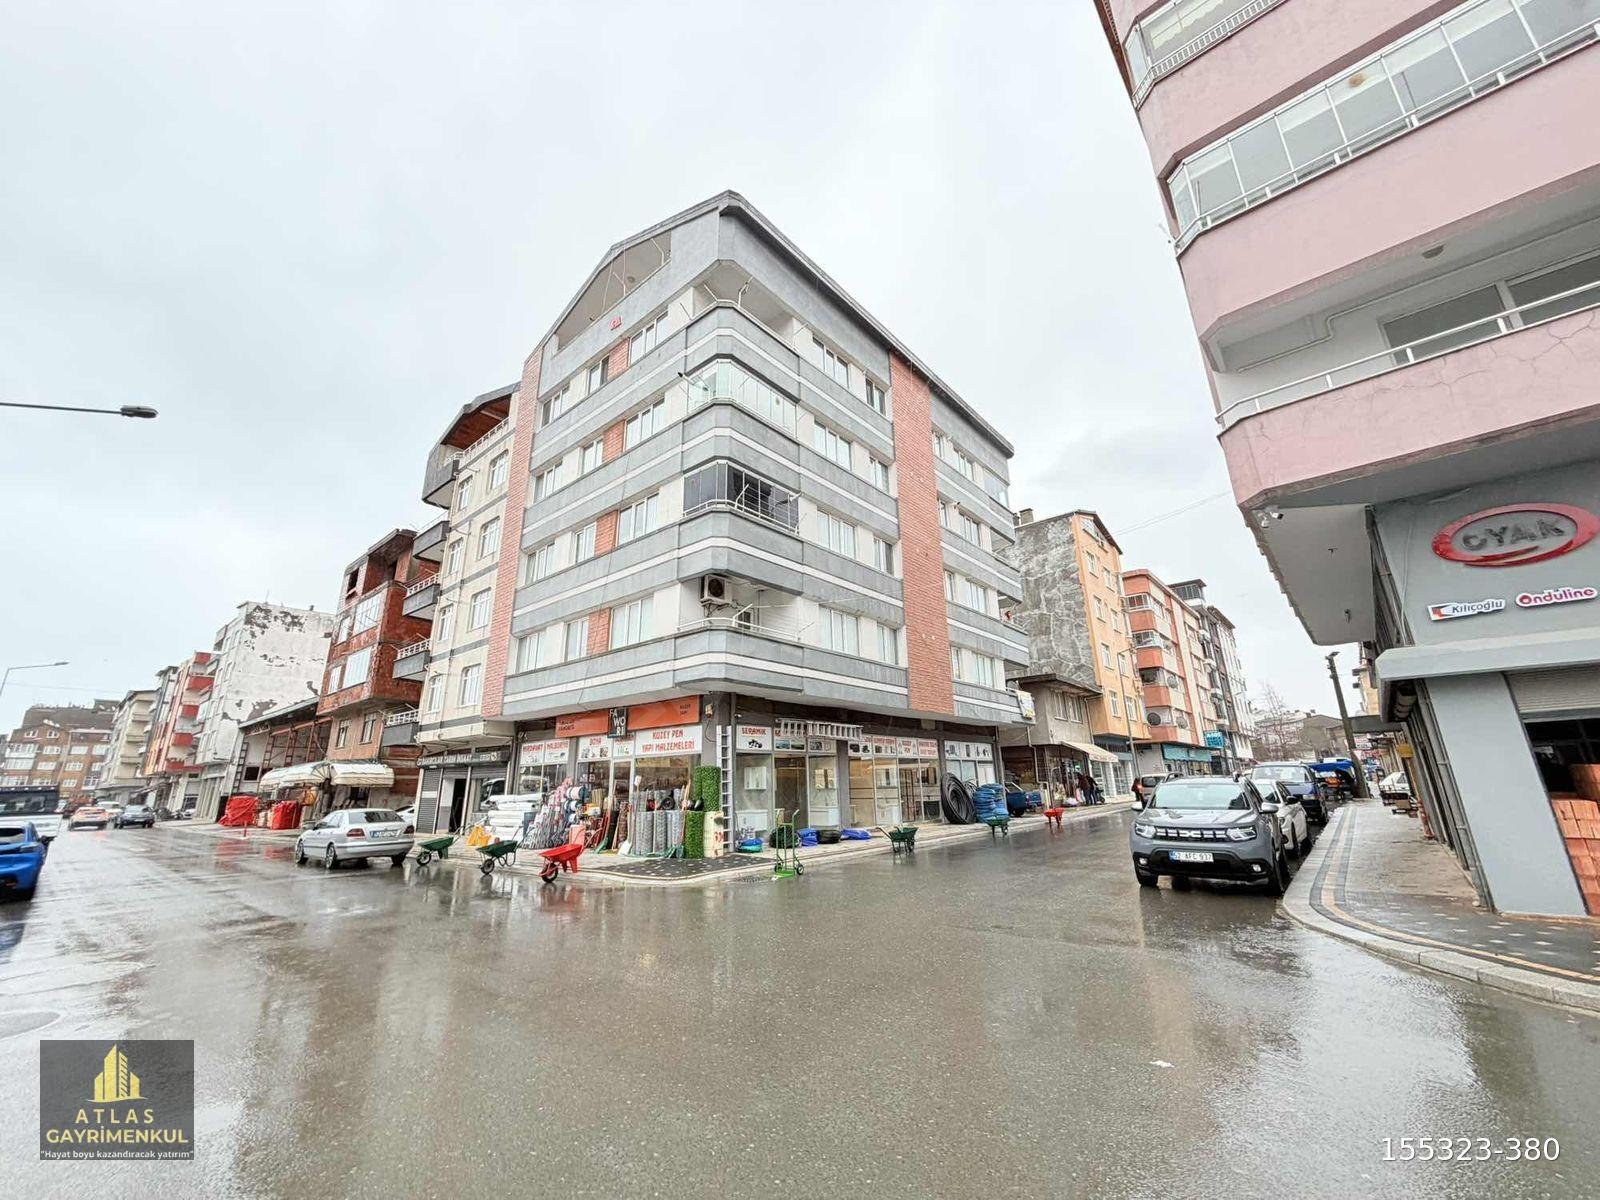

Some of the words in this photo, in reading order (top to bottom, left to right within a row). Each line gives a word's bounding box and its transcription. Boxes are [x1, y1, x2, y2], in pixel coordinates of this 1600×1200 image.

[1519, 588, 1594, 605] Onduline
[1452, 600, 1503, 614] Kılıçoğlu
[613, 716, 627, 726] WO
[652, 730, 670, 739] KUZEY
[672, 729, 683, 738] PEN
[642, 743, 653, 752] YAPI
